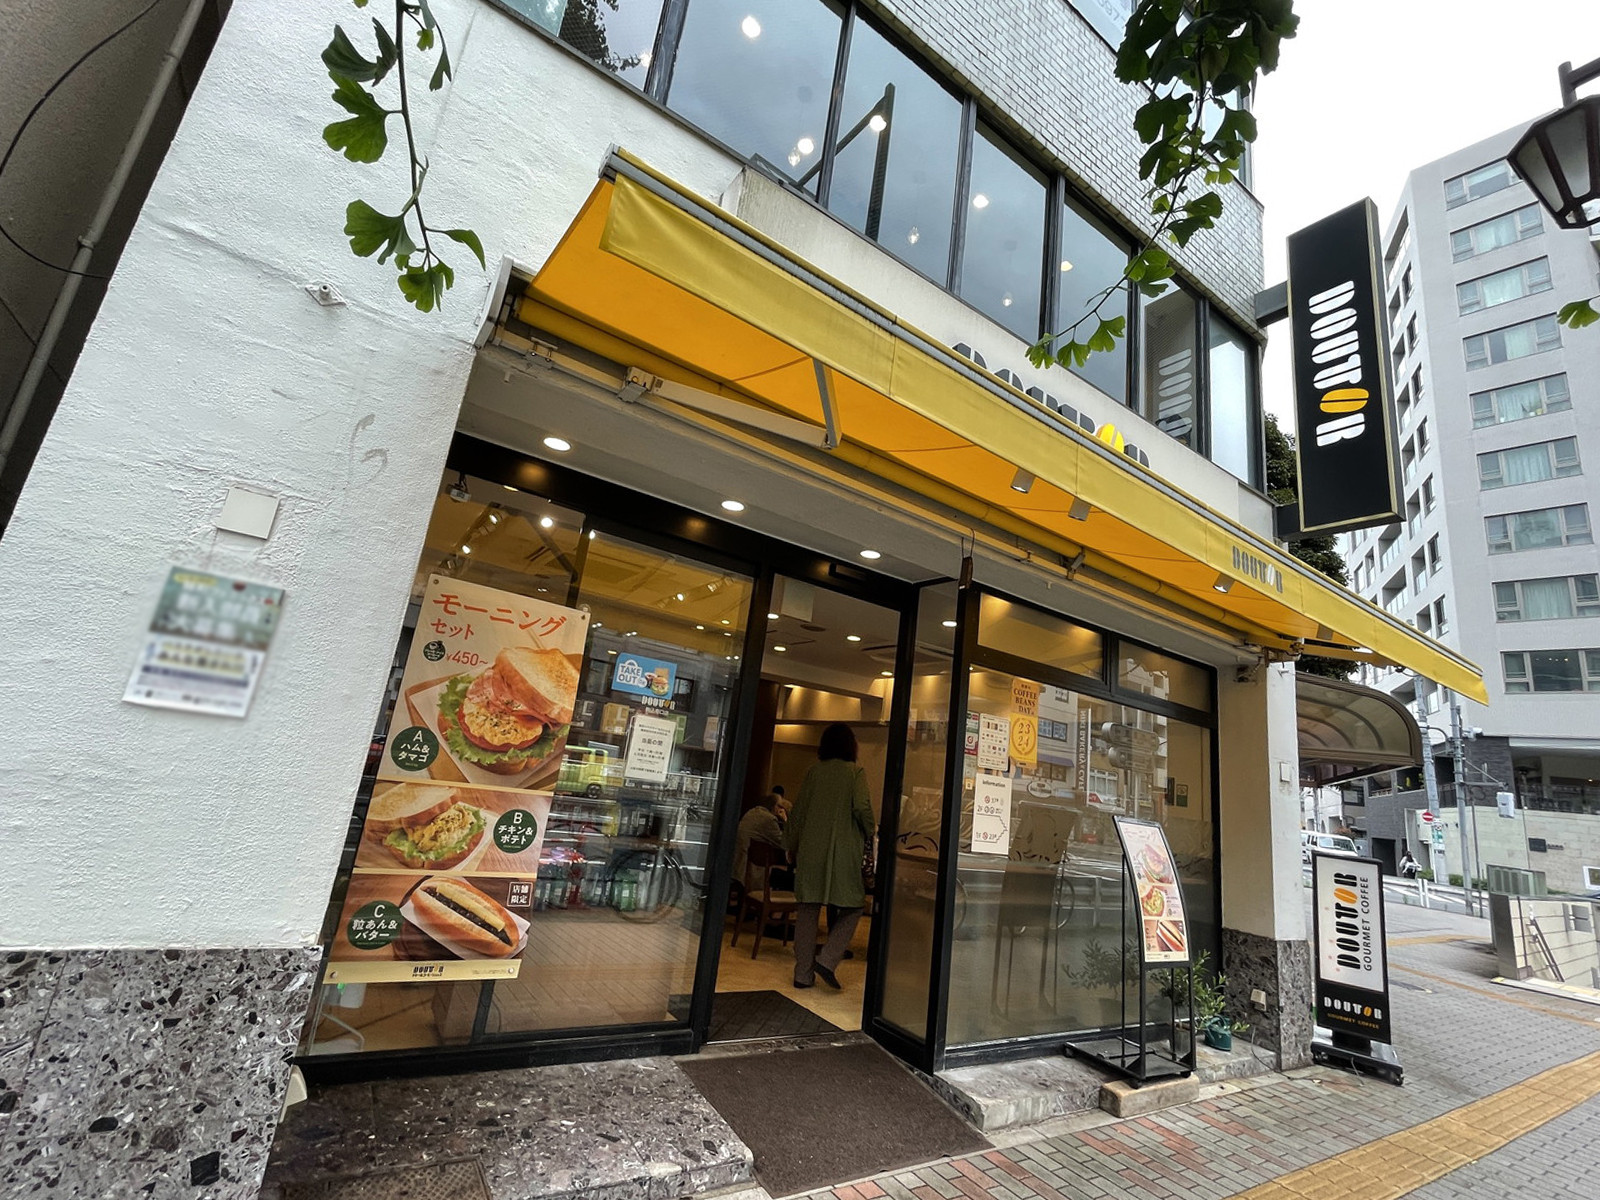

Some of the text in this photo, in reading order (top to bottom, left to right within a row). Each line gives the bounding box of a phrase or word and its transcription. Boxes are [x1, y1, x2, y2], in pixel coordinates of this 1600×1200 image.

[1308, 280, 1369, 447] DOUTOR
[1232, 545, 1283, 593] DOUTOR
[433, 593, 567, 637] モーニング
[430, 617, 474, 640] セット
[620, 665, 641, 676] TAKE
[618, 674, 637, 683] OUT
[1013, 688, 1037, 699] COFFEE
[641, 695, 676, 710] DOUTOR
[1015, 696, 1035, 707] BEANS
[1018, 723, 1031, 734] 23
[413, 730, 423, 742] A
[1018, 736, 1030, 747] 24
[400, 743, 430, 753] ハム&
[398, 751, 429, 762] タマゴ
[513, 812, 523, 824] B
[498, 825, 534, 836] チキン&
[500, 834, 527, 845] ポテト
[510, 895, 528, 904] 限定
[373, 904, 386, 918] C
[352, 919, 397, 931] 粒あん&
[1333, 872, 1361, 970] DOUTOR
[1359, 876, 1373, 971] GOURMET COFFEE
[354, 930, 390, 941] バター
[1324, 996, 1382, 1020] DOUTOR
